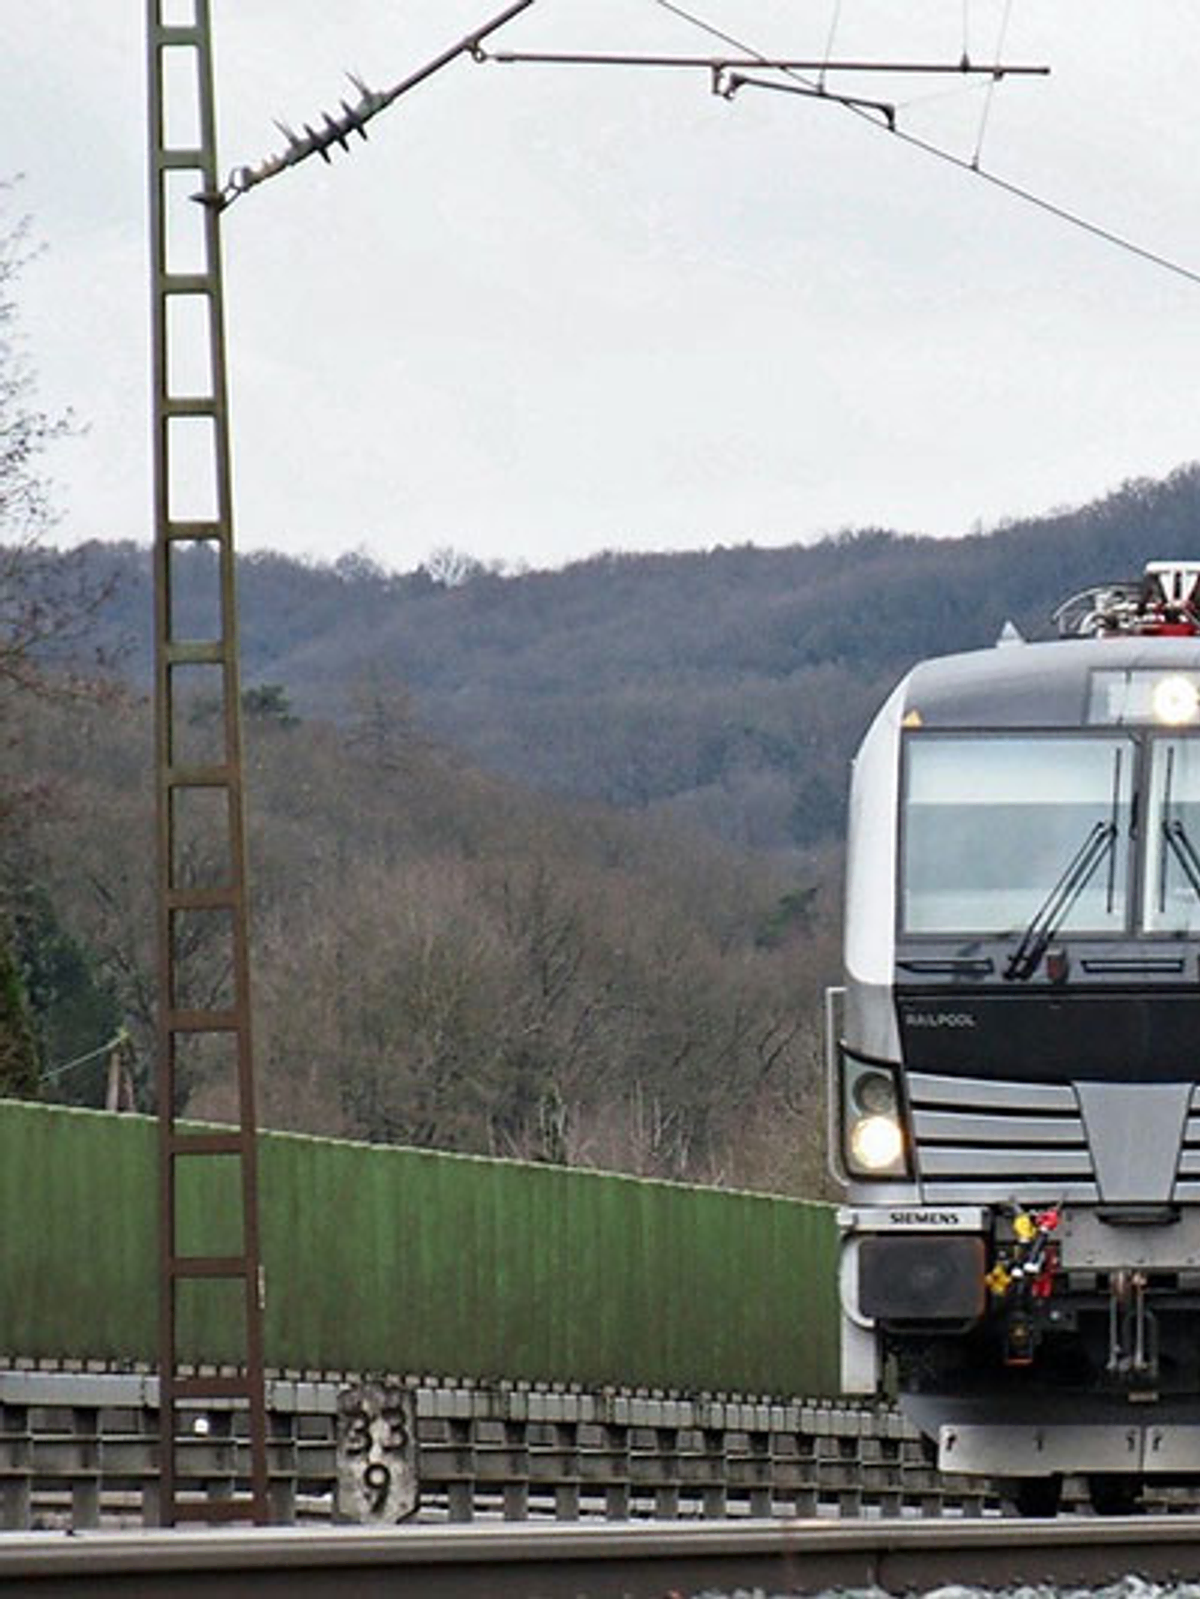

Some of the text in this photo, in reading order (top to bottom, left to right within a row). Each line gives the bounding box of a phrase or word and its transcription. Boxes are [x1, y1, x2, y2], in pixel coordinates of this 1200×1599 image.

[889, 1211, 960, 1225] SIEMENS
[345, 1408, 409, 1456] 33
[363, 1463, 391, 1513] 9
